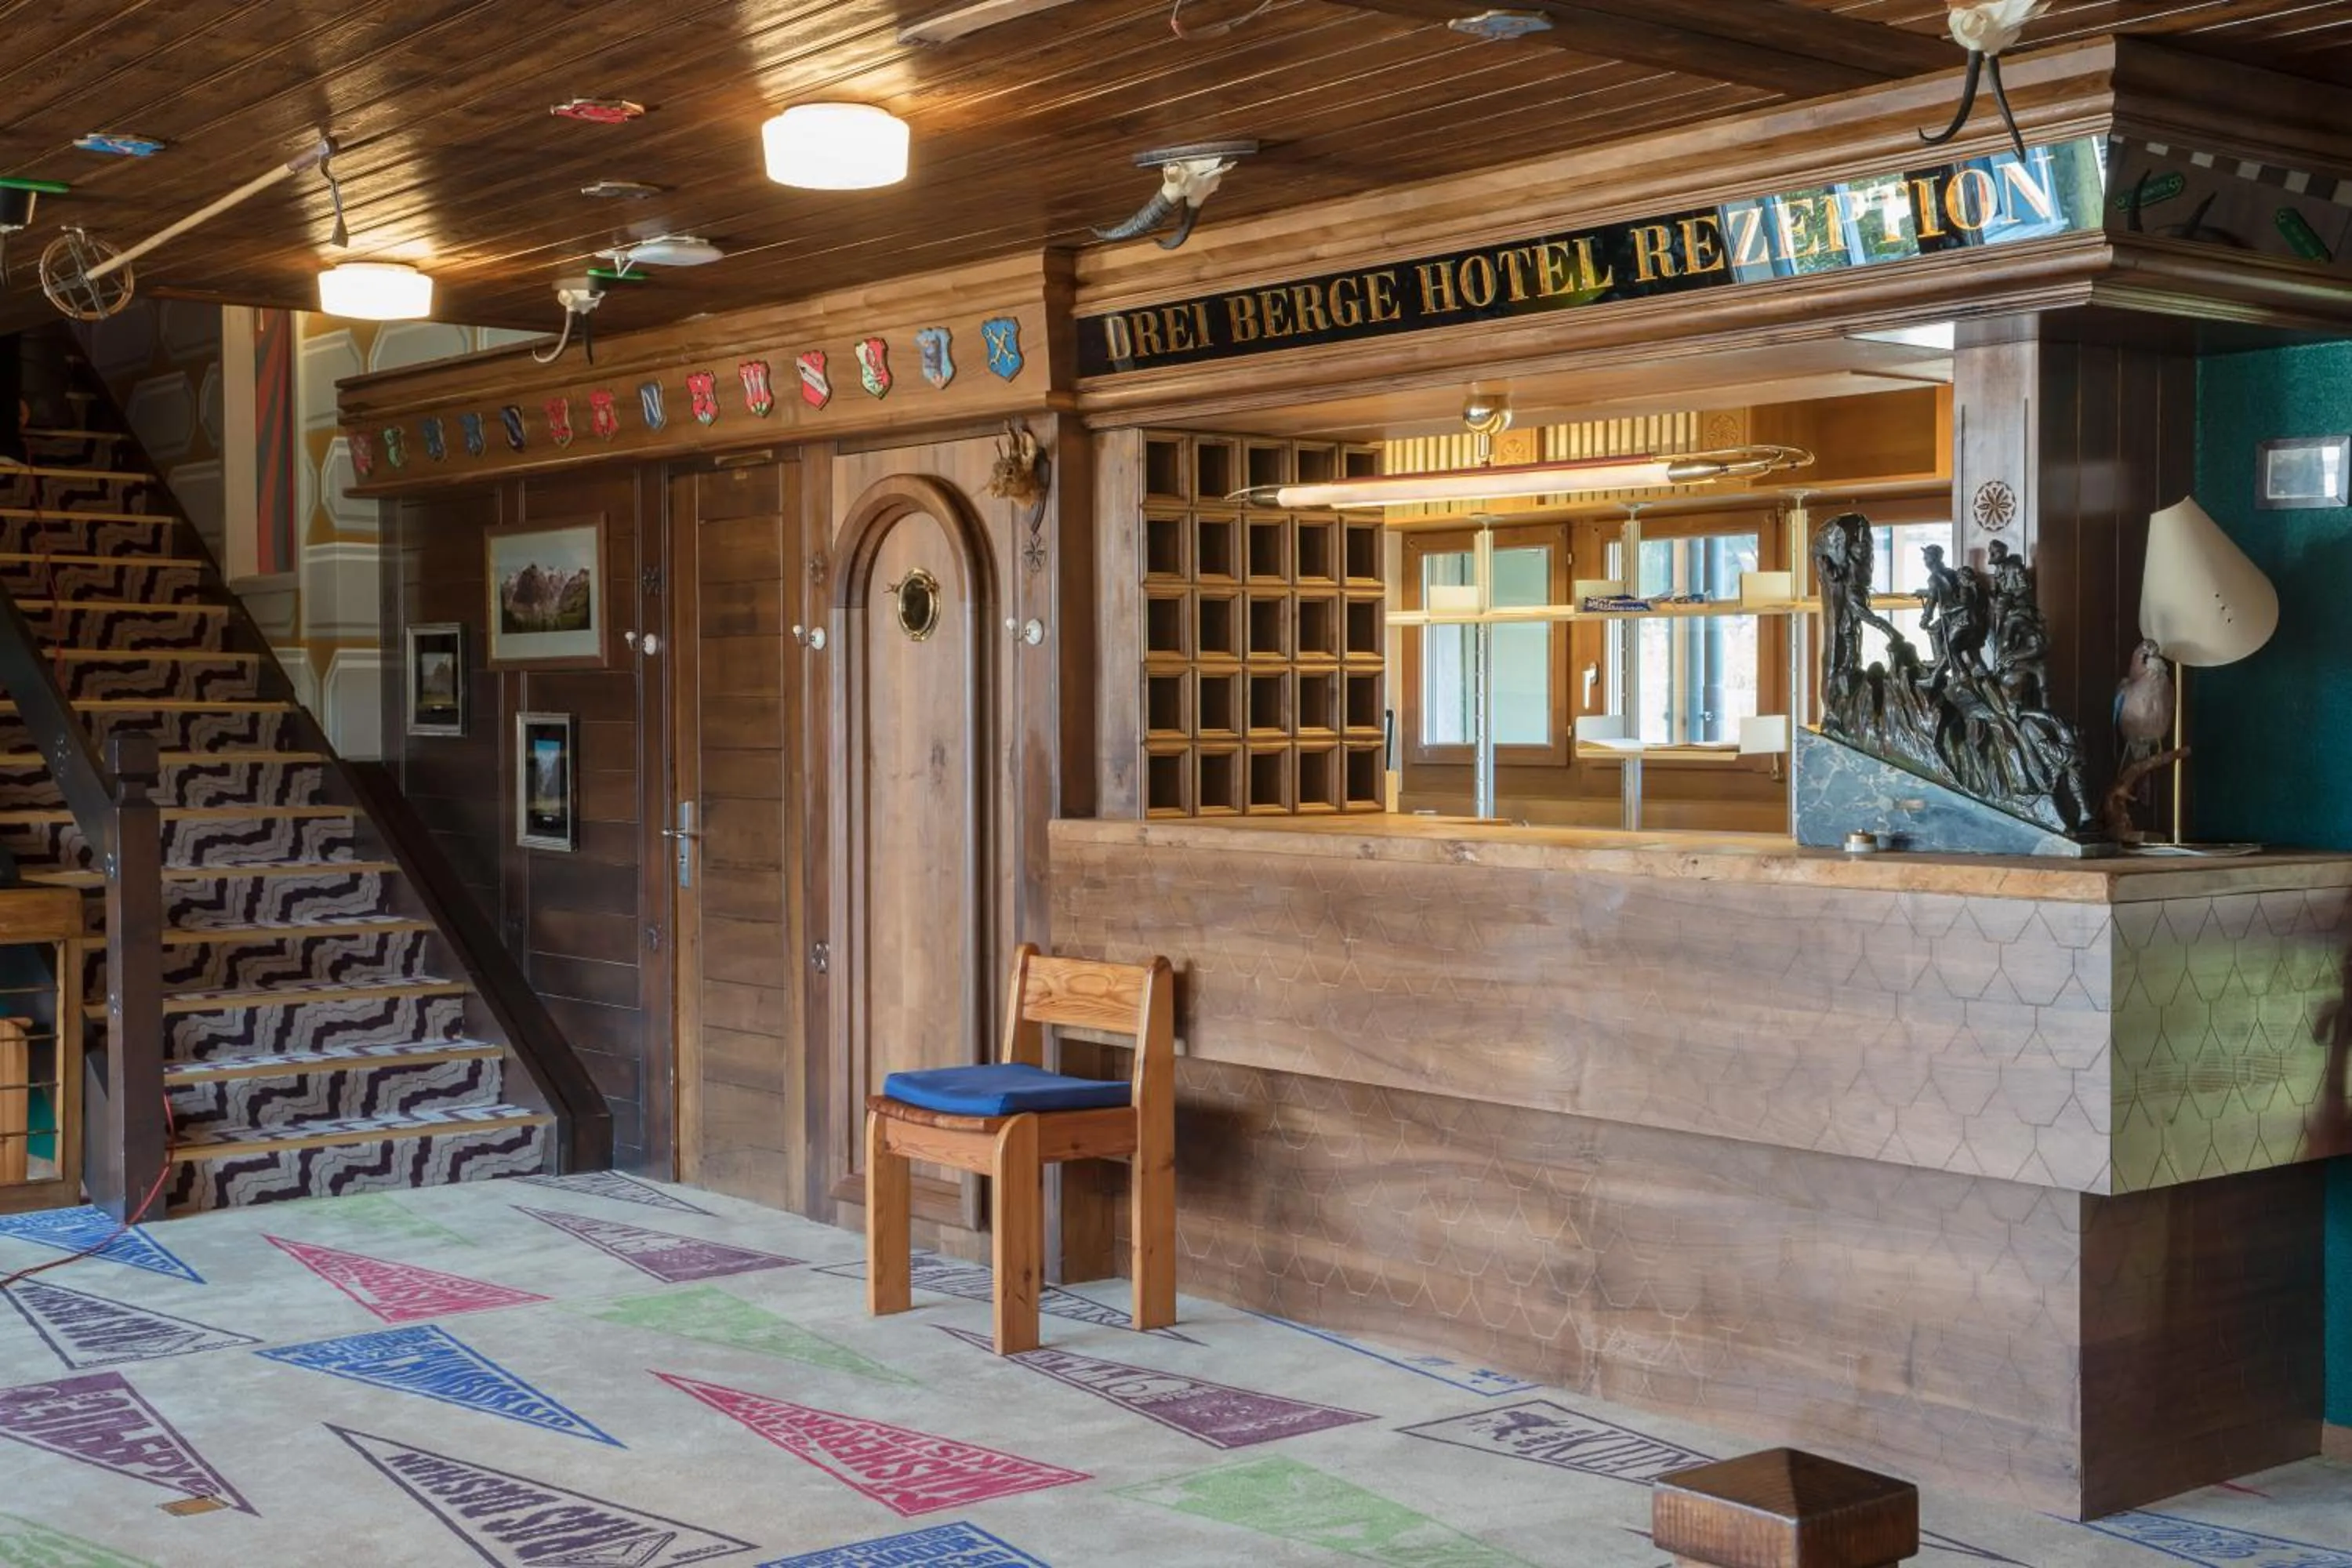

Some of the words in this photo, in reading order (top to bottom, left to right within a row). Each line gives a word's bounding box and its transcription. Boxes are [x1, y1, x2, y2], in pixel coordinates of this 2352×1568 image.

[1105, 303, 1213, 361] DREI
[1225, 270, 1401, 344] BERGE
[1416, 237, 1614, 314] HOTEL
[1629, 154, 2056, 282] REZEPTION
[382, 1451, 561, 1518] DASHAN
